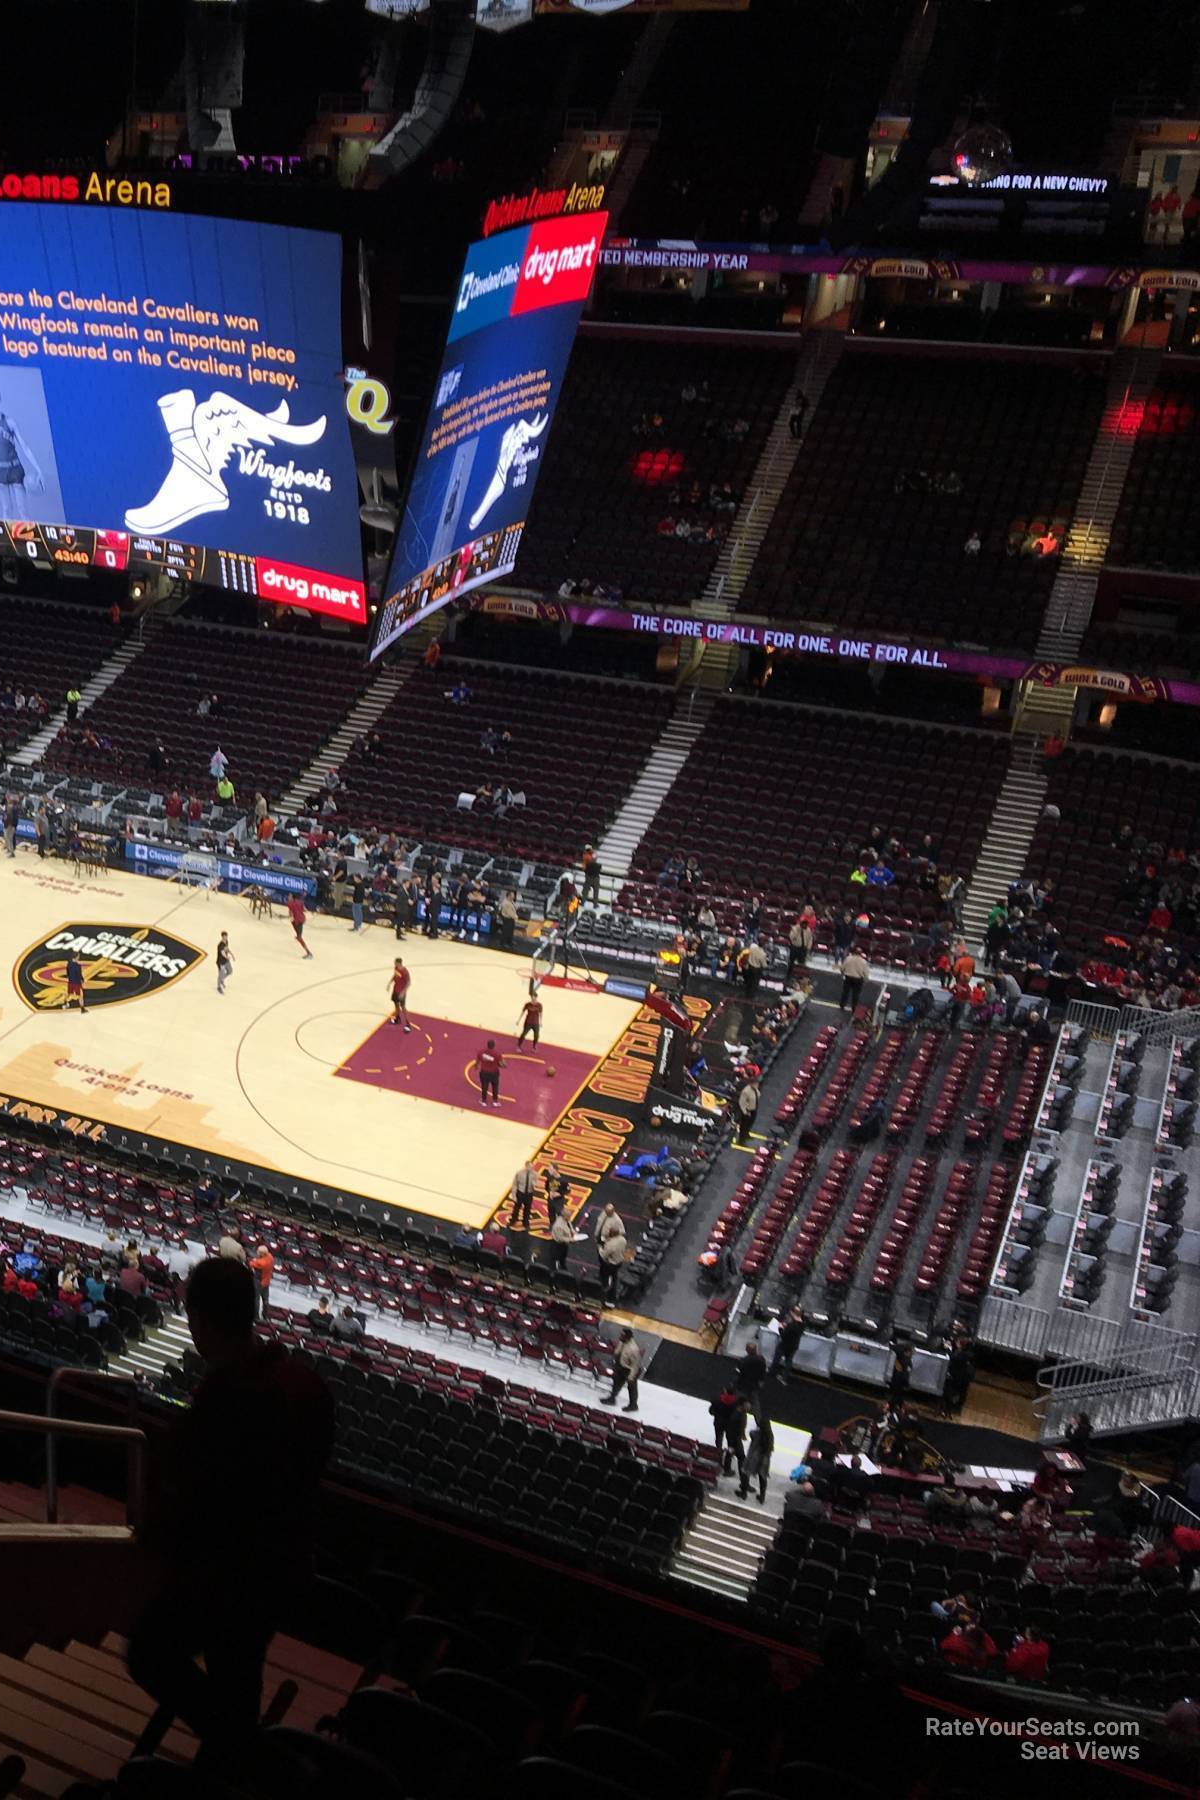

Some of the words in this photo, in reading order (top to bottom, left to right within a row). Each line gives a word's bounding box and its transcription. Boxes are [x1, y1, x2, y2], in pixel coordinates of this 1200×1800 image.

[85, 171, 171, 207] Arena
[1012, 175, 1031, 189] FOR
[1033, 176, 1041, 189] A
[1043, 176, 1068, 190] NEW
[1068, 177, 1108, 193] CHEVY?
[527, 188, 566, 219] Loans
[564, 182, 604, 212] Arena
[525, 246, 557, 284] drug
[558, 237, 596, 273] mart
[624, 252, 709, 269] MEMBERSHIP
[713, 254, 748, 270] YEAR
[470, 267, 502, 299] Cleveland
[29, 288, 52, 307] the
[57, 291, 138, 316] Cleveland
[142, 299, 219, 326] Cavaliers
[224, 313, 259, 332] won
[84, 320, 138, 340] remain
[144, 328, 163, 343] an
[169, 328, 246, 355] important
[251, 341, 296, 363] piece
[2, 335, 38, 358] logo
[43, 337, 107, 361] featured
[112, 348, 132, 362] on
[138, 346, 161, 366] the
[167, 350, 242, 379] Cavaliers
[248, 363, 299, 391] jersey.
[345, 368, 366, 384] The
[347, 379, 394, 434] Q
[237, 446, 332, 492] Wingfoots
[264, 499, 309, 524] 1918
[26, 541, 38, 558] 0
[54, 549, 90, 564] 43:40
[105, 551, 116, 567] 0
[263, 568, 309, 598] drug
[312, 581, 360, 608] mart
[631, 614, 659, 632] THE
[663, 618, 702, 637] CORE
[707, 622, 728, 638] OF
[729, 625, 759, 645] ALL
[763, 630, 795, 649] FOR
[798, 634, 834, 654] ONE.
[838, 640, 871, 659] ONE
[875, 644, 907, 664] FOR
[911, 649, 948, 669] ALL.
[1100, 676, 1125, 690] GOLD
[14, 869, 75, 886] Quicken
[36, 881, 80, 895] Arena
[243, 869, 283, 886] Cleveland
[285, 879, 308, 891] Clinic
[44, 932, 187, 978] CAVALIERS
[97, 931, 166, 954] CLEVELAND
[54, 1057, 131, 1083] Quicken
[134, 1079, 195, 1100] Loans
[81, 1076, 139, 1097] Arena
[652, 1104, 681, 1124] drug
